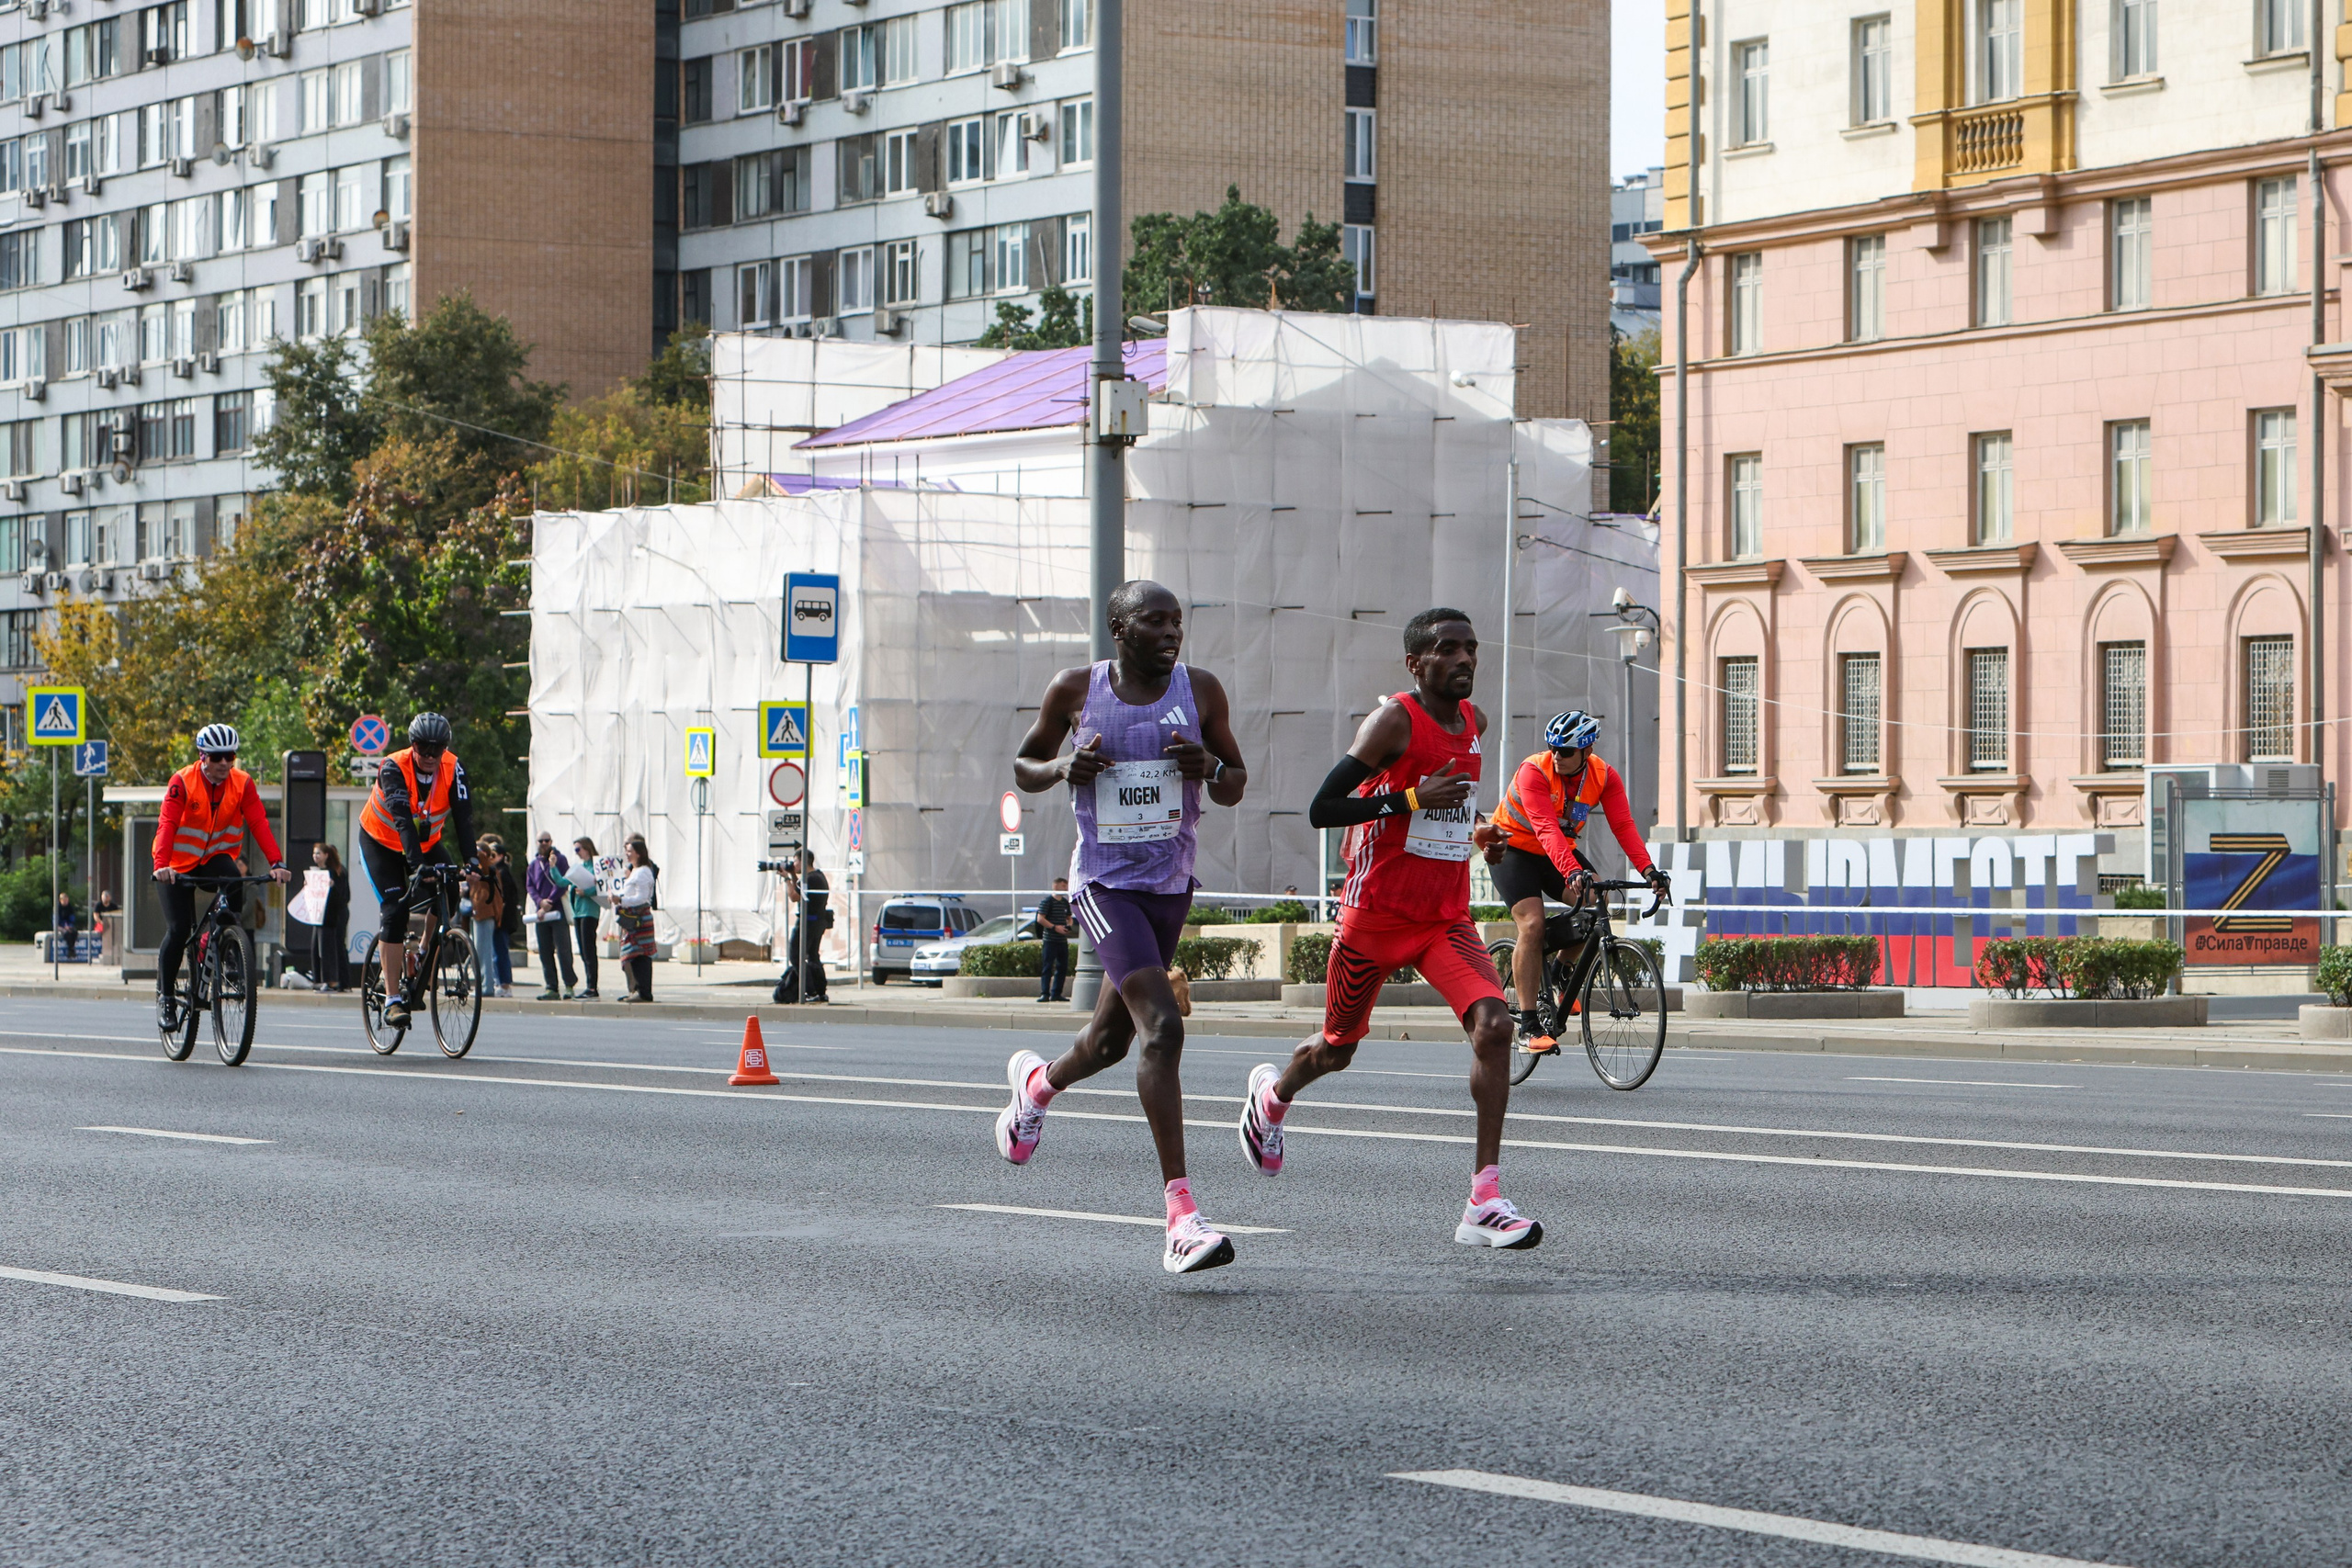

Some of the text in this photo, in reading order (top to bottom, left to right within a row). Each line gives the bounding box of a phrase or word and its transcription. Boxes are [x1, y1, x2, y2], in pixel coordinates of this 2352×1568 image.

[1139, 770, 1159, 779] 42,2
[1162, 769, 1176, 777] KM
[1118, 785, 1160, 807] KIGEN
[1445, 830, 1453, 839] 12
[594, 856, 624, 875] SEXY
[2209, 832, 2293, 934] Z
